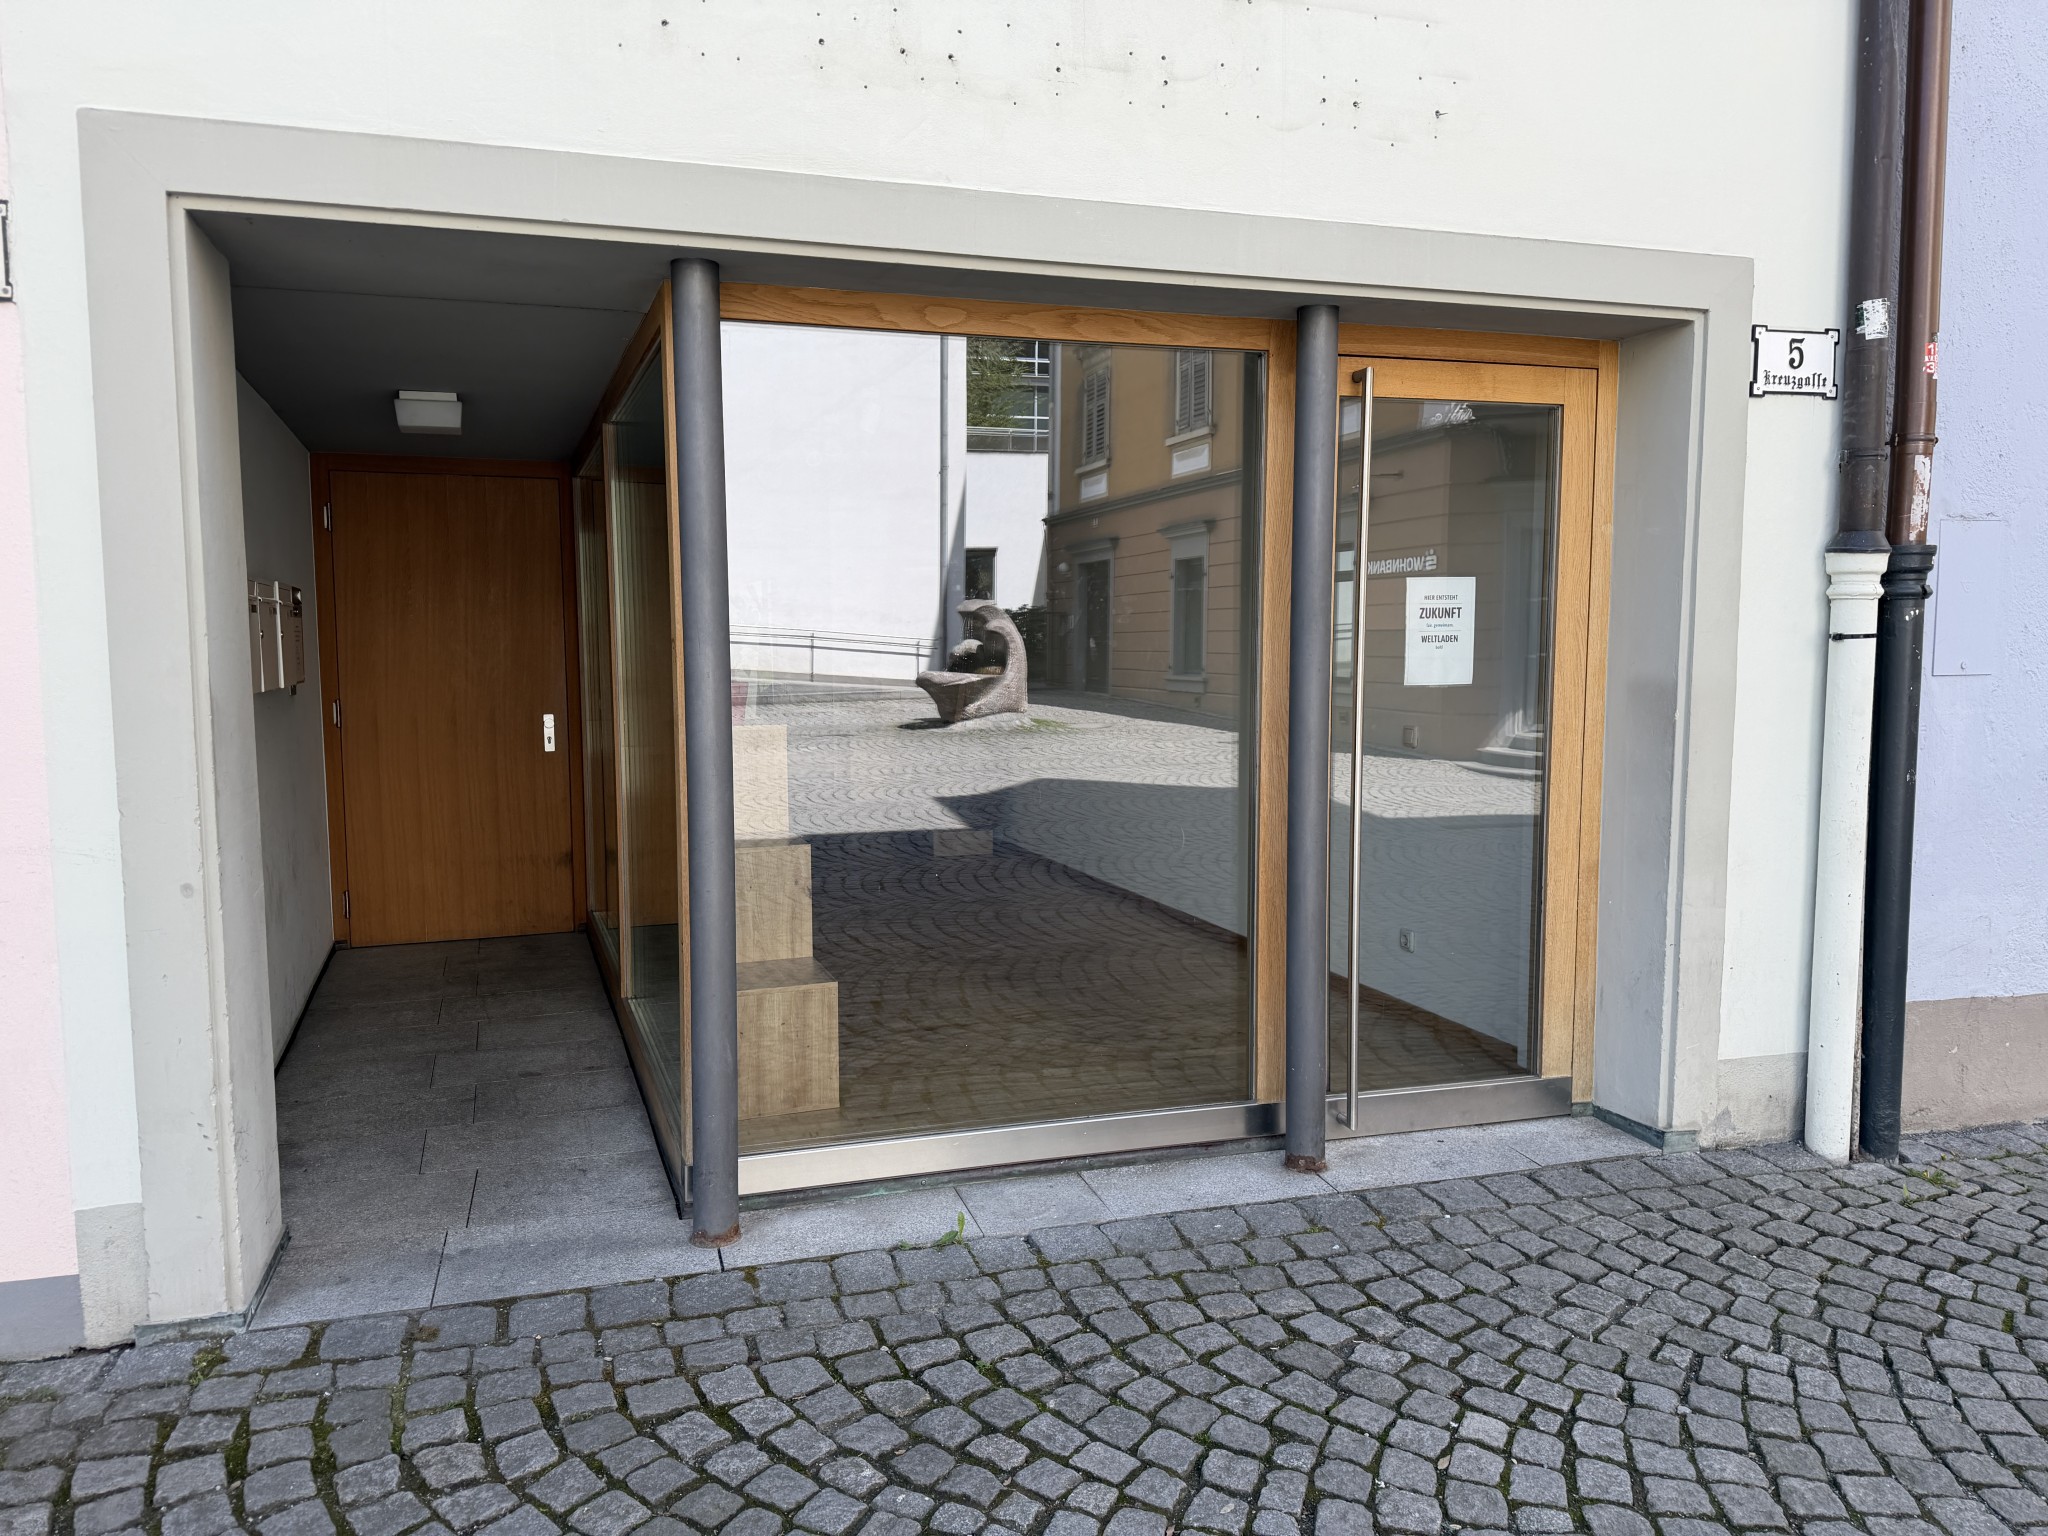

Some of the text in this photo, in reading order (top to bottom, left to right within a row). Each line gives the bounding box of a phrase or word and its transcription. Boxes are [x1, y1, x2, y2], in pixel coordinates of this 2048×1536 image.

[1788, 338, 1805, 369] 5
[1419, 607, 1462, 619] ZUKUNFT
[1421, 635, 1459, 643] WELTLADEN
